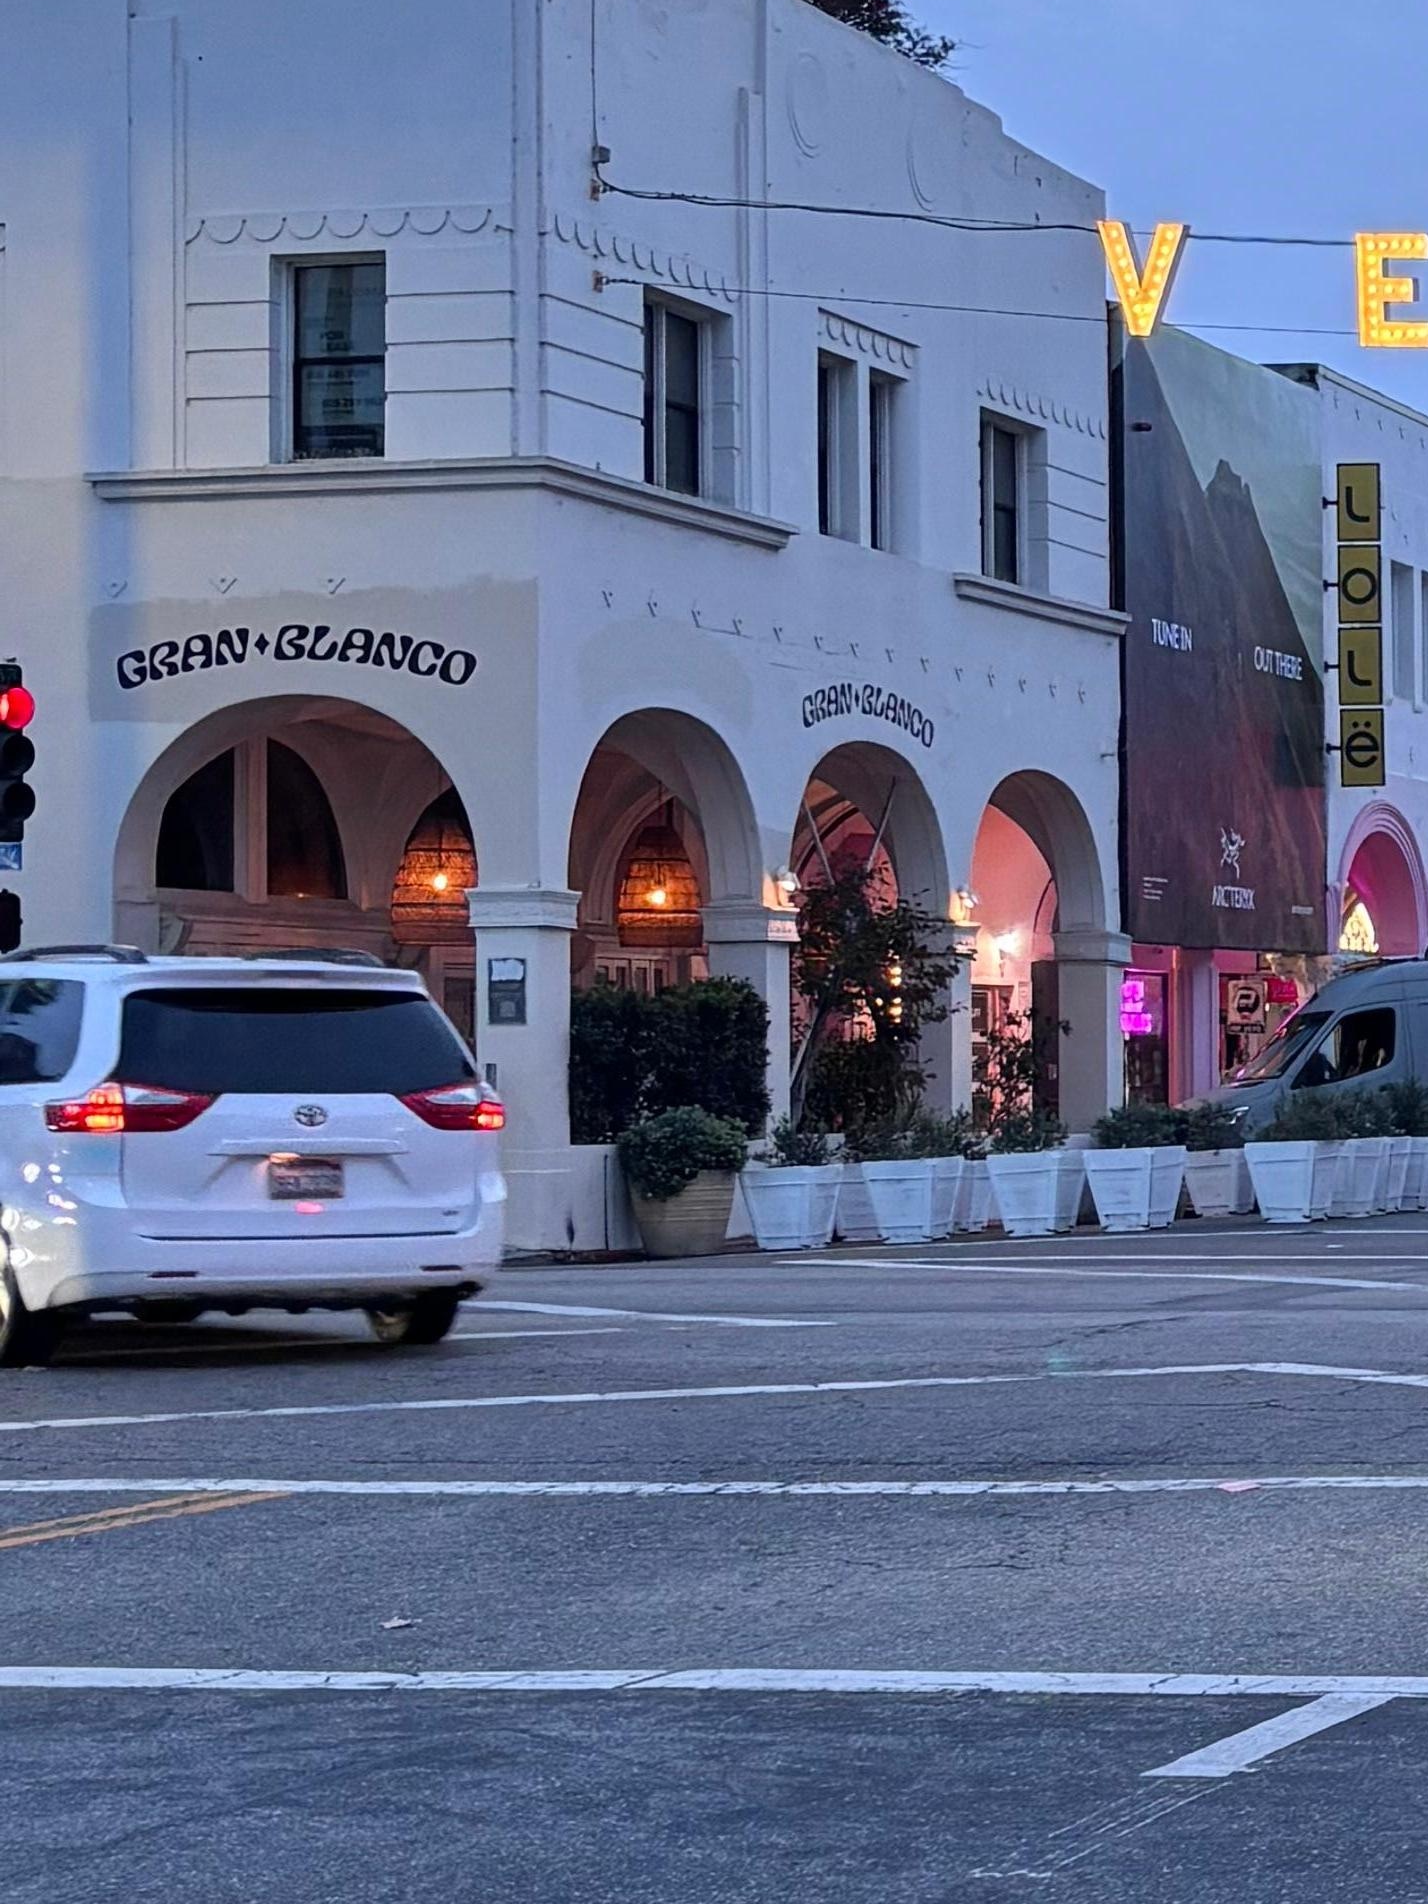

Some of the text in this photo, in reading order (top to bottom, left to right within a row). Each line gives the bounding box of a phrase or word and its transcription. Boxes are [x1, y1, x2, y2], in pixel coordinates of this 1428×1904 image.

[116, 624, 477, 690] GRAN BLANCO
[1151, 618, 1193, 652] TUNE IN
[1253, 646, 1303, 681] OUT THERE
[802, 682, 935, 748] GRAN BLANCO
